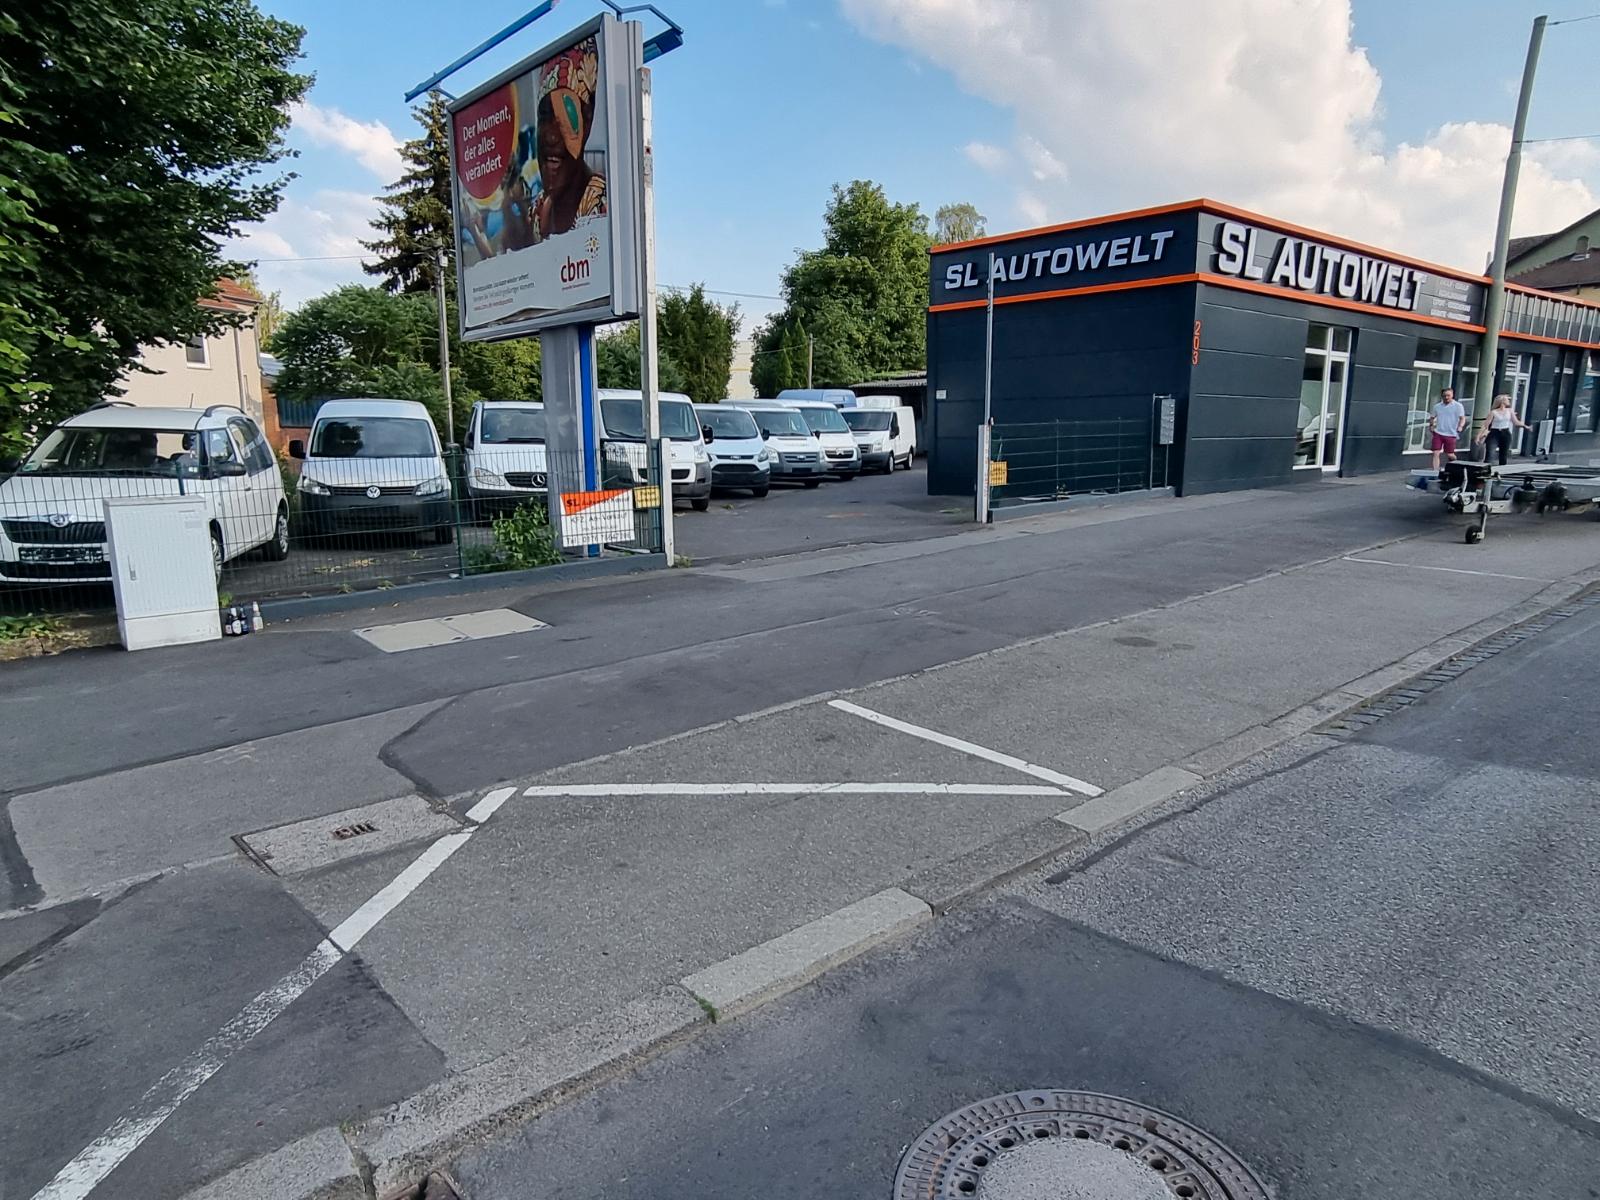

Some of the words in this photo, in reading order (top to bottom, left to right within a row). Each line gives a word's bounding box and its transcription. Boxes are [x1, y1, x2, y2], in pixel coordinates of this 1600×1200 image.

[463, 125, 476, 142] Der
[476, 105, 511, 135] Moment,
[464, 145, 477, 162] der
[477, 136, 496, 157] alles
[465, 154, 502, 182] verändert
[560, 255, 590, 283] cbm
[944, 262, 978, 290] SL
[987, 230, 1174, 284] AUTOWELT
[1217, 221, 1264, 280] SL
[1271, 237, 1427, 312] AUTOWELT
[1191, 320, 1201, 366] 203
